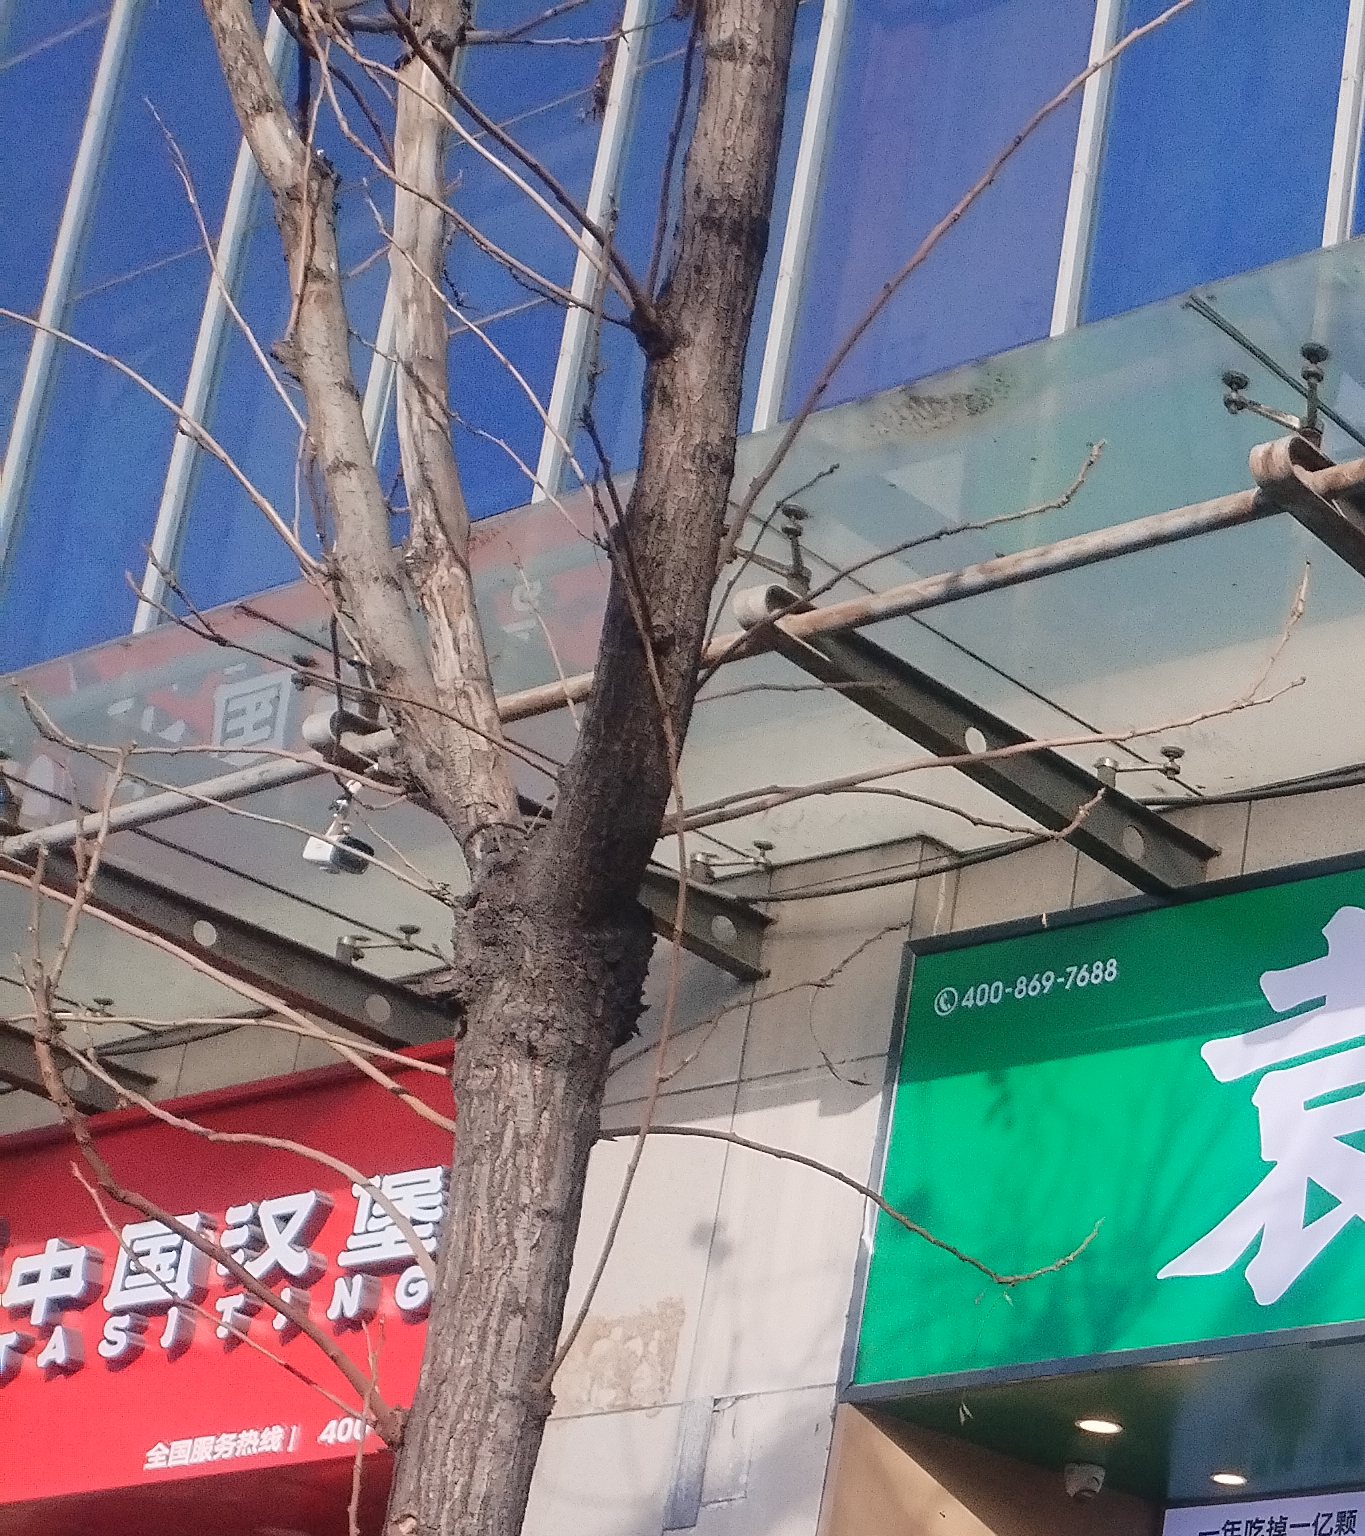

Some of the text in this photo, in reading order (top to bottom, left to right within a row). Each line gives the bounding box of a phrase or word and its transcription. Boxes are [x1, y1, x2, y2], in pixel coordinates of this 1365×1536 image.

[960, 957, 1119, 1010] 400-869-7688
[2, 1166, 446, 1328] 中国汉堡
[143, 1424, 287, 1471] 全国服务热线
